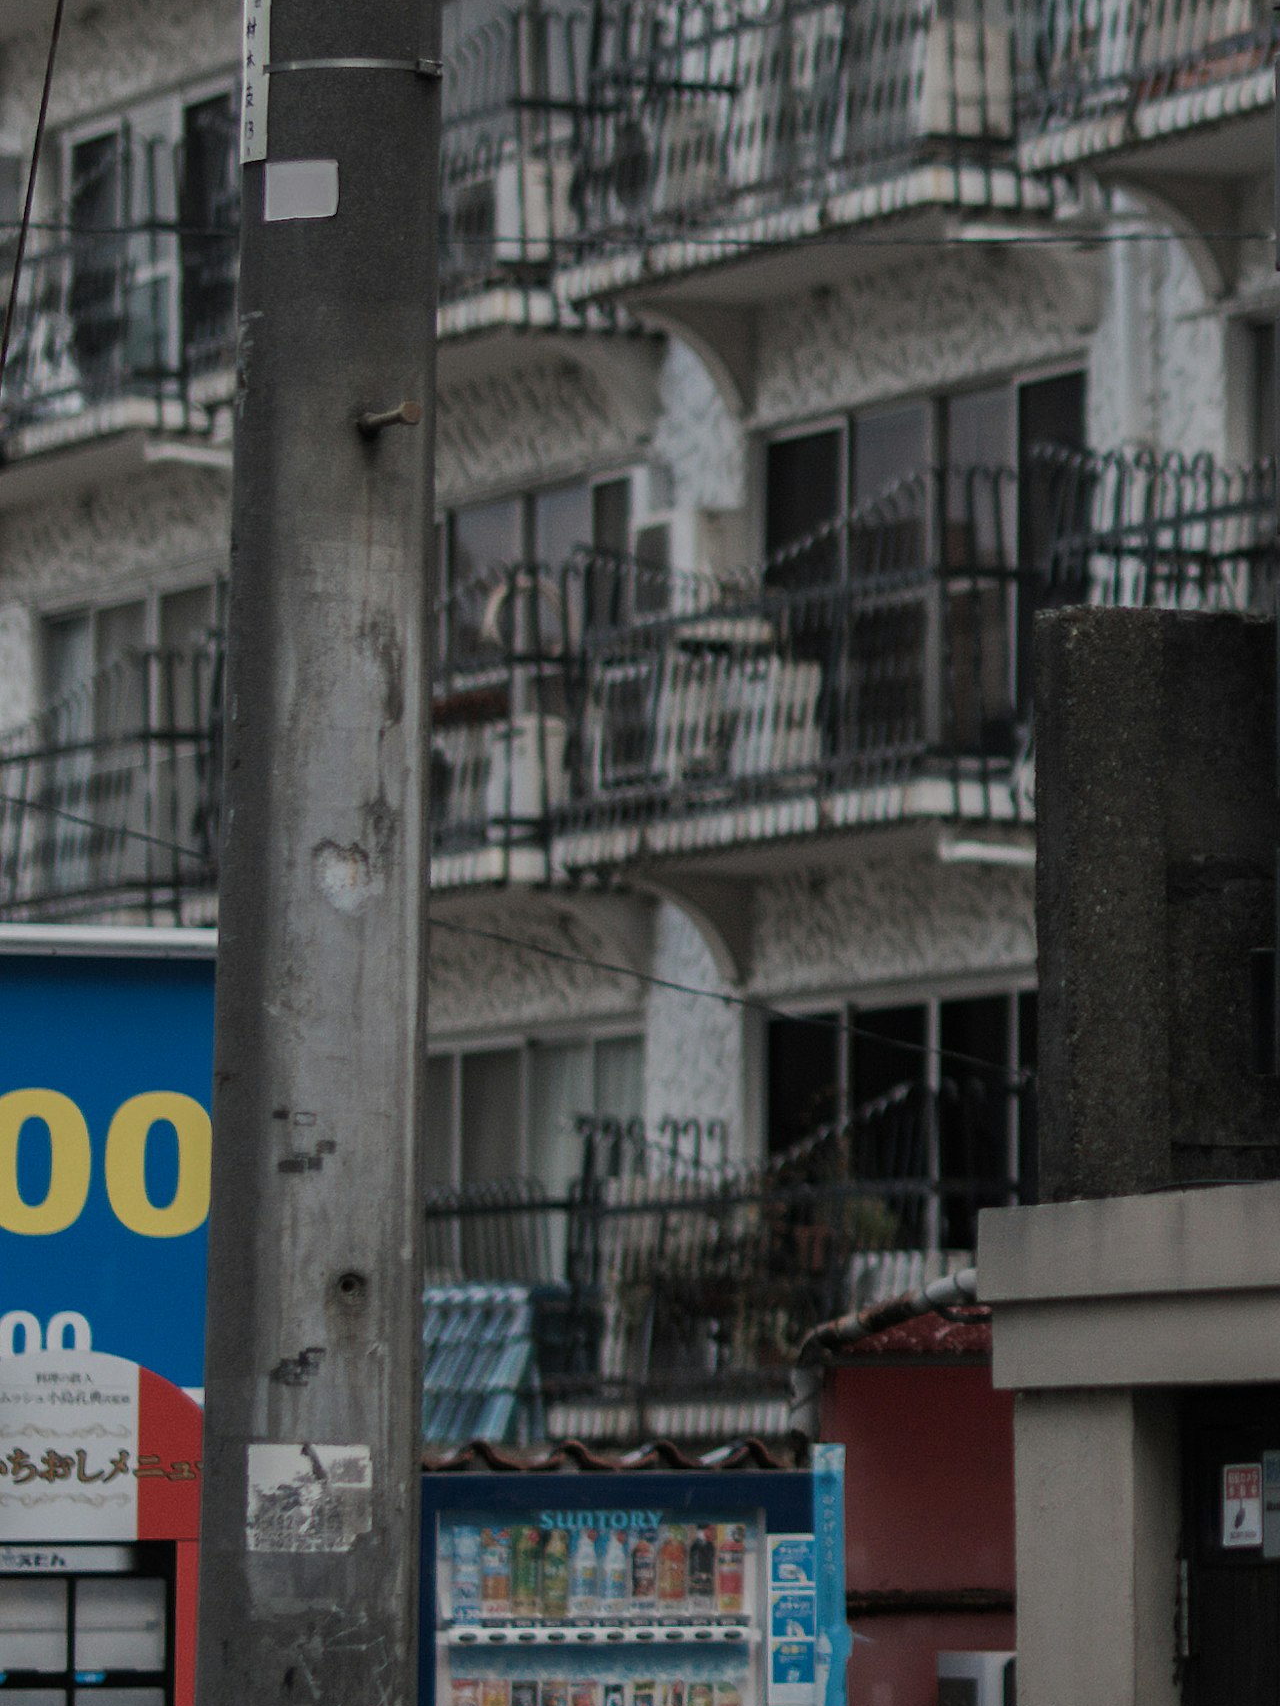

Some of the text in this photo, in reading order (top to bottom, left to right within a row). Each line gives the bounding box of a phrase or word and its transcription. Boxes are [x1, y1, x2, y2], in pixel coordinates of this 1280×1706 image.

[0, 1446, 203, 1485] ちおしメニュ
